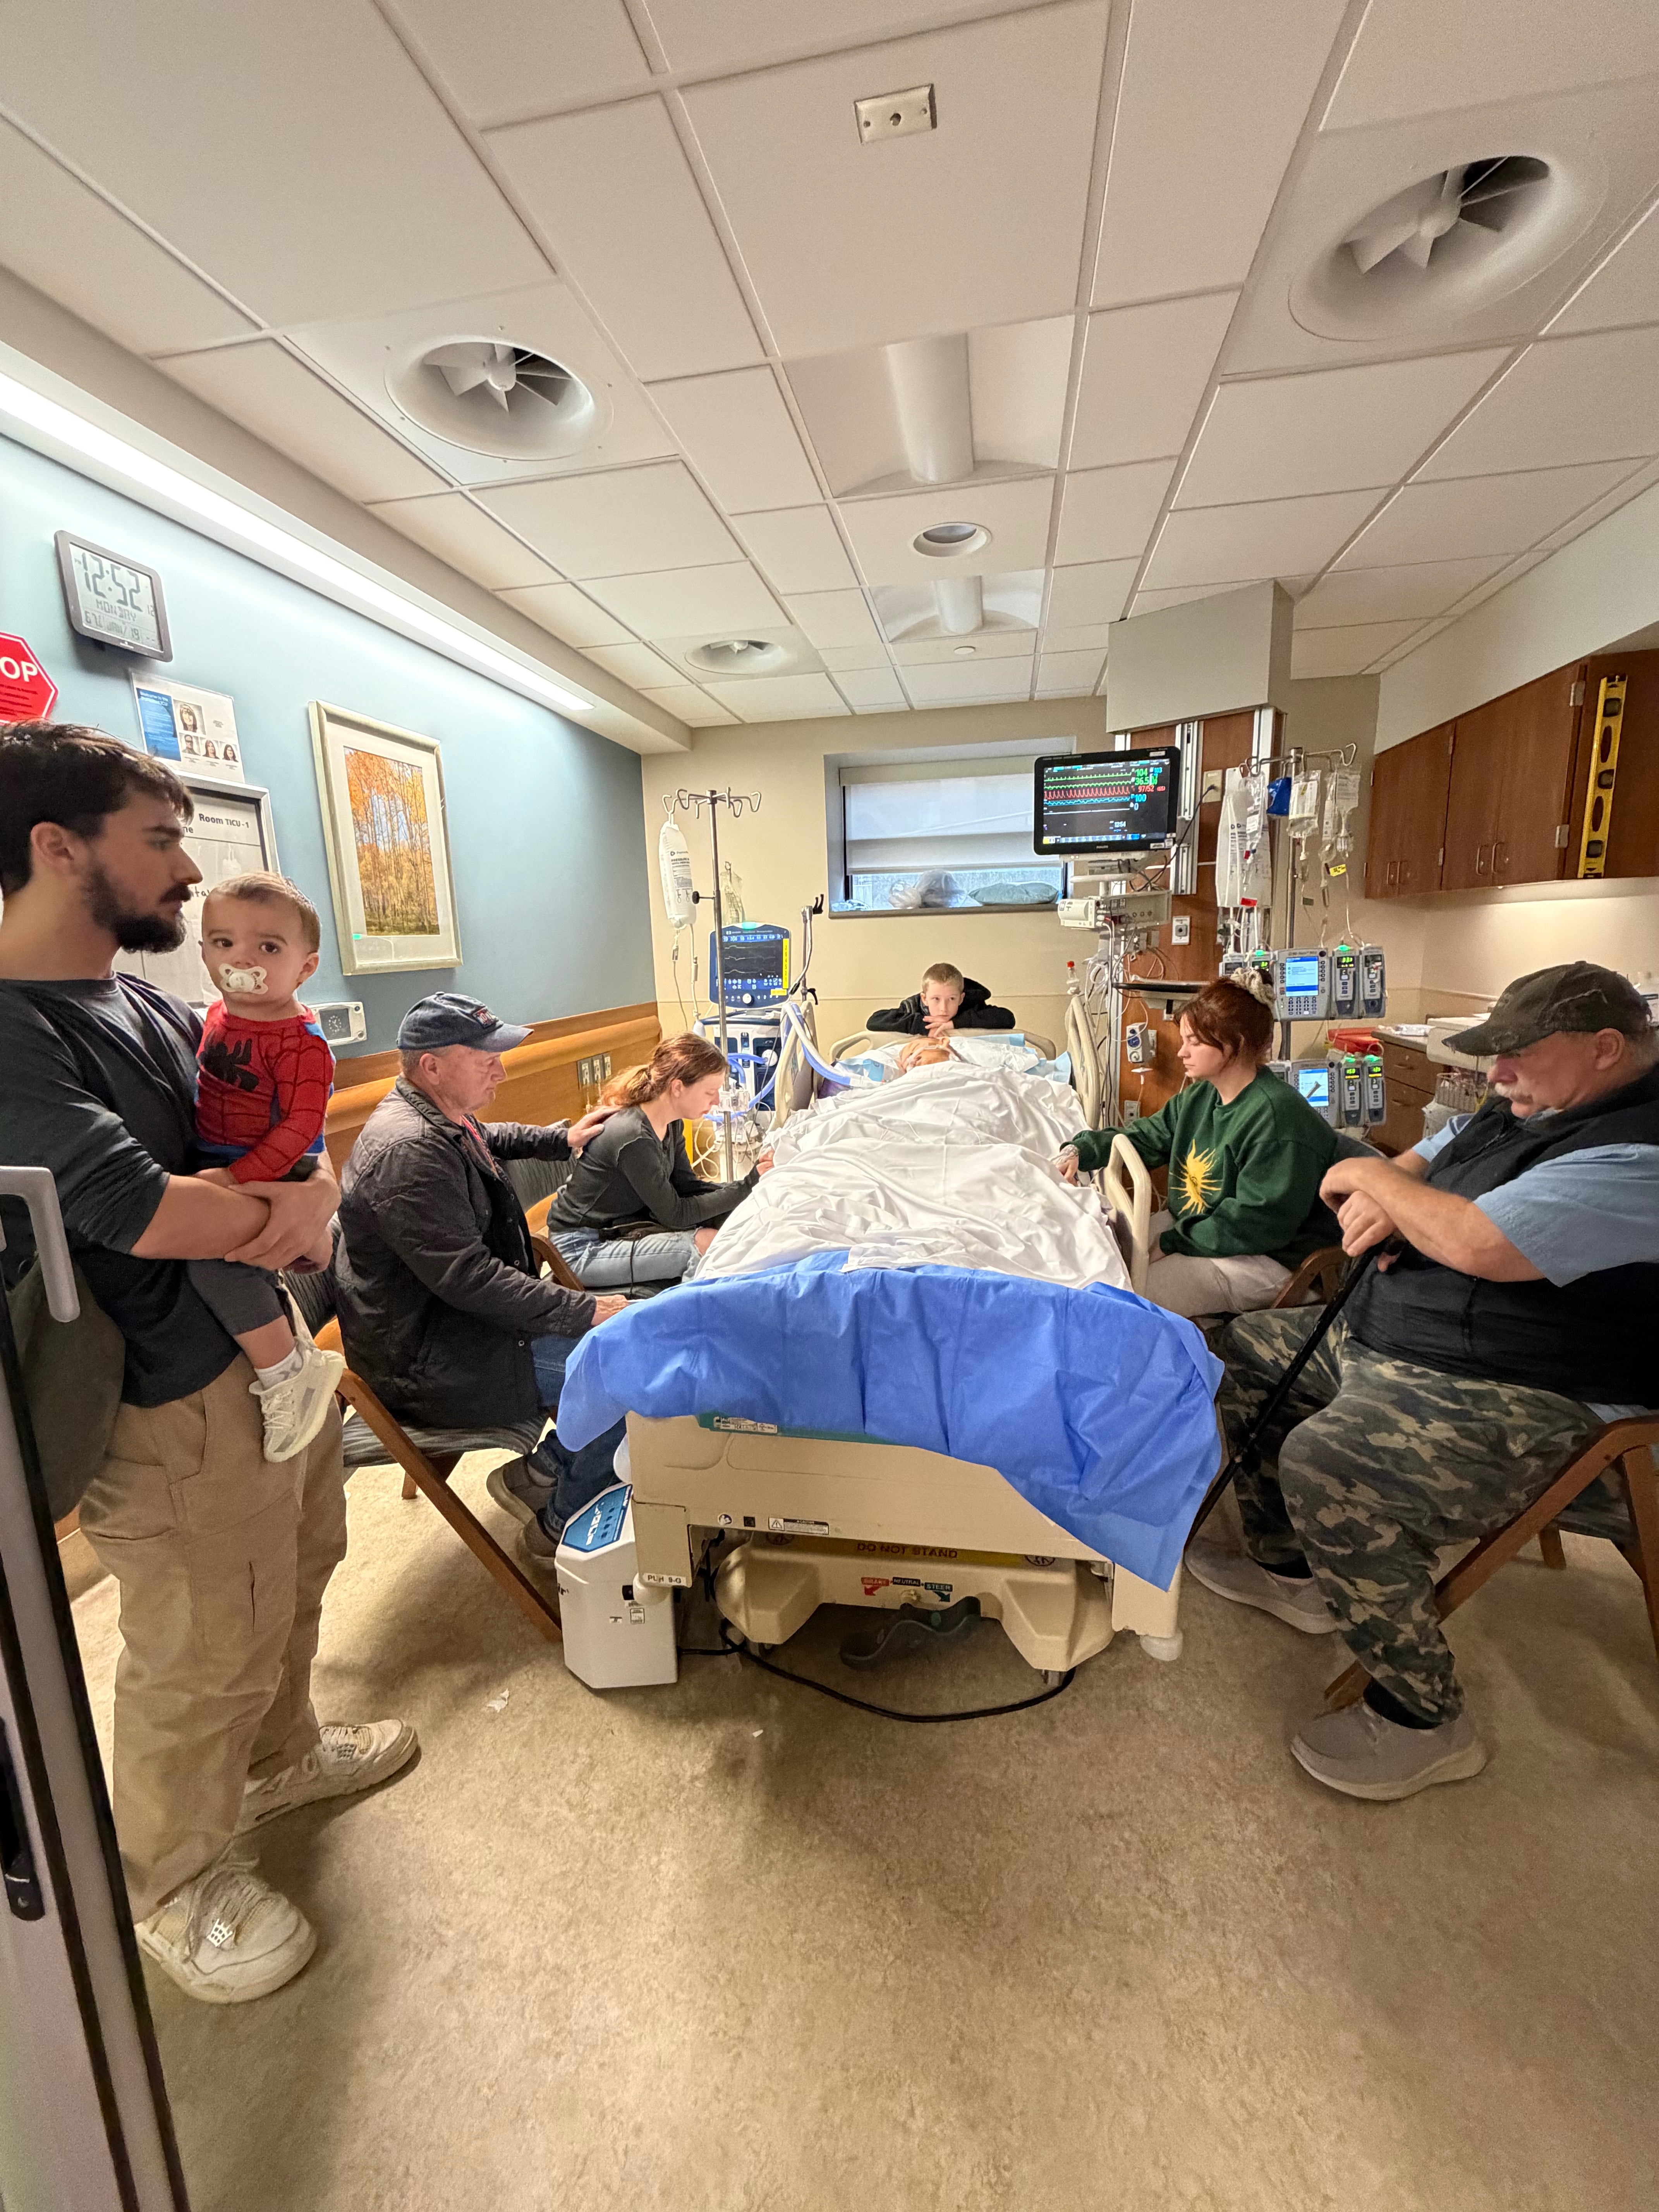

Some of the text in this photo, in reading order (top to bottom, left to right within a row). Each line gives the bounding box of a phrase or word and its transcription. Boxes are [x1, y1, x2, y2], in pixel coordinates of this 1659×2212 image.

[81, 552, 143, 612] 12:52
[96, 598, 136, 622] MONDAY
[0, 657, 38, 682] OP
[199, 814, 223, 824] Room
[225, 819, 241, 827] TICU
[857, 1543, 958, 1559] DO NOT STAND
